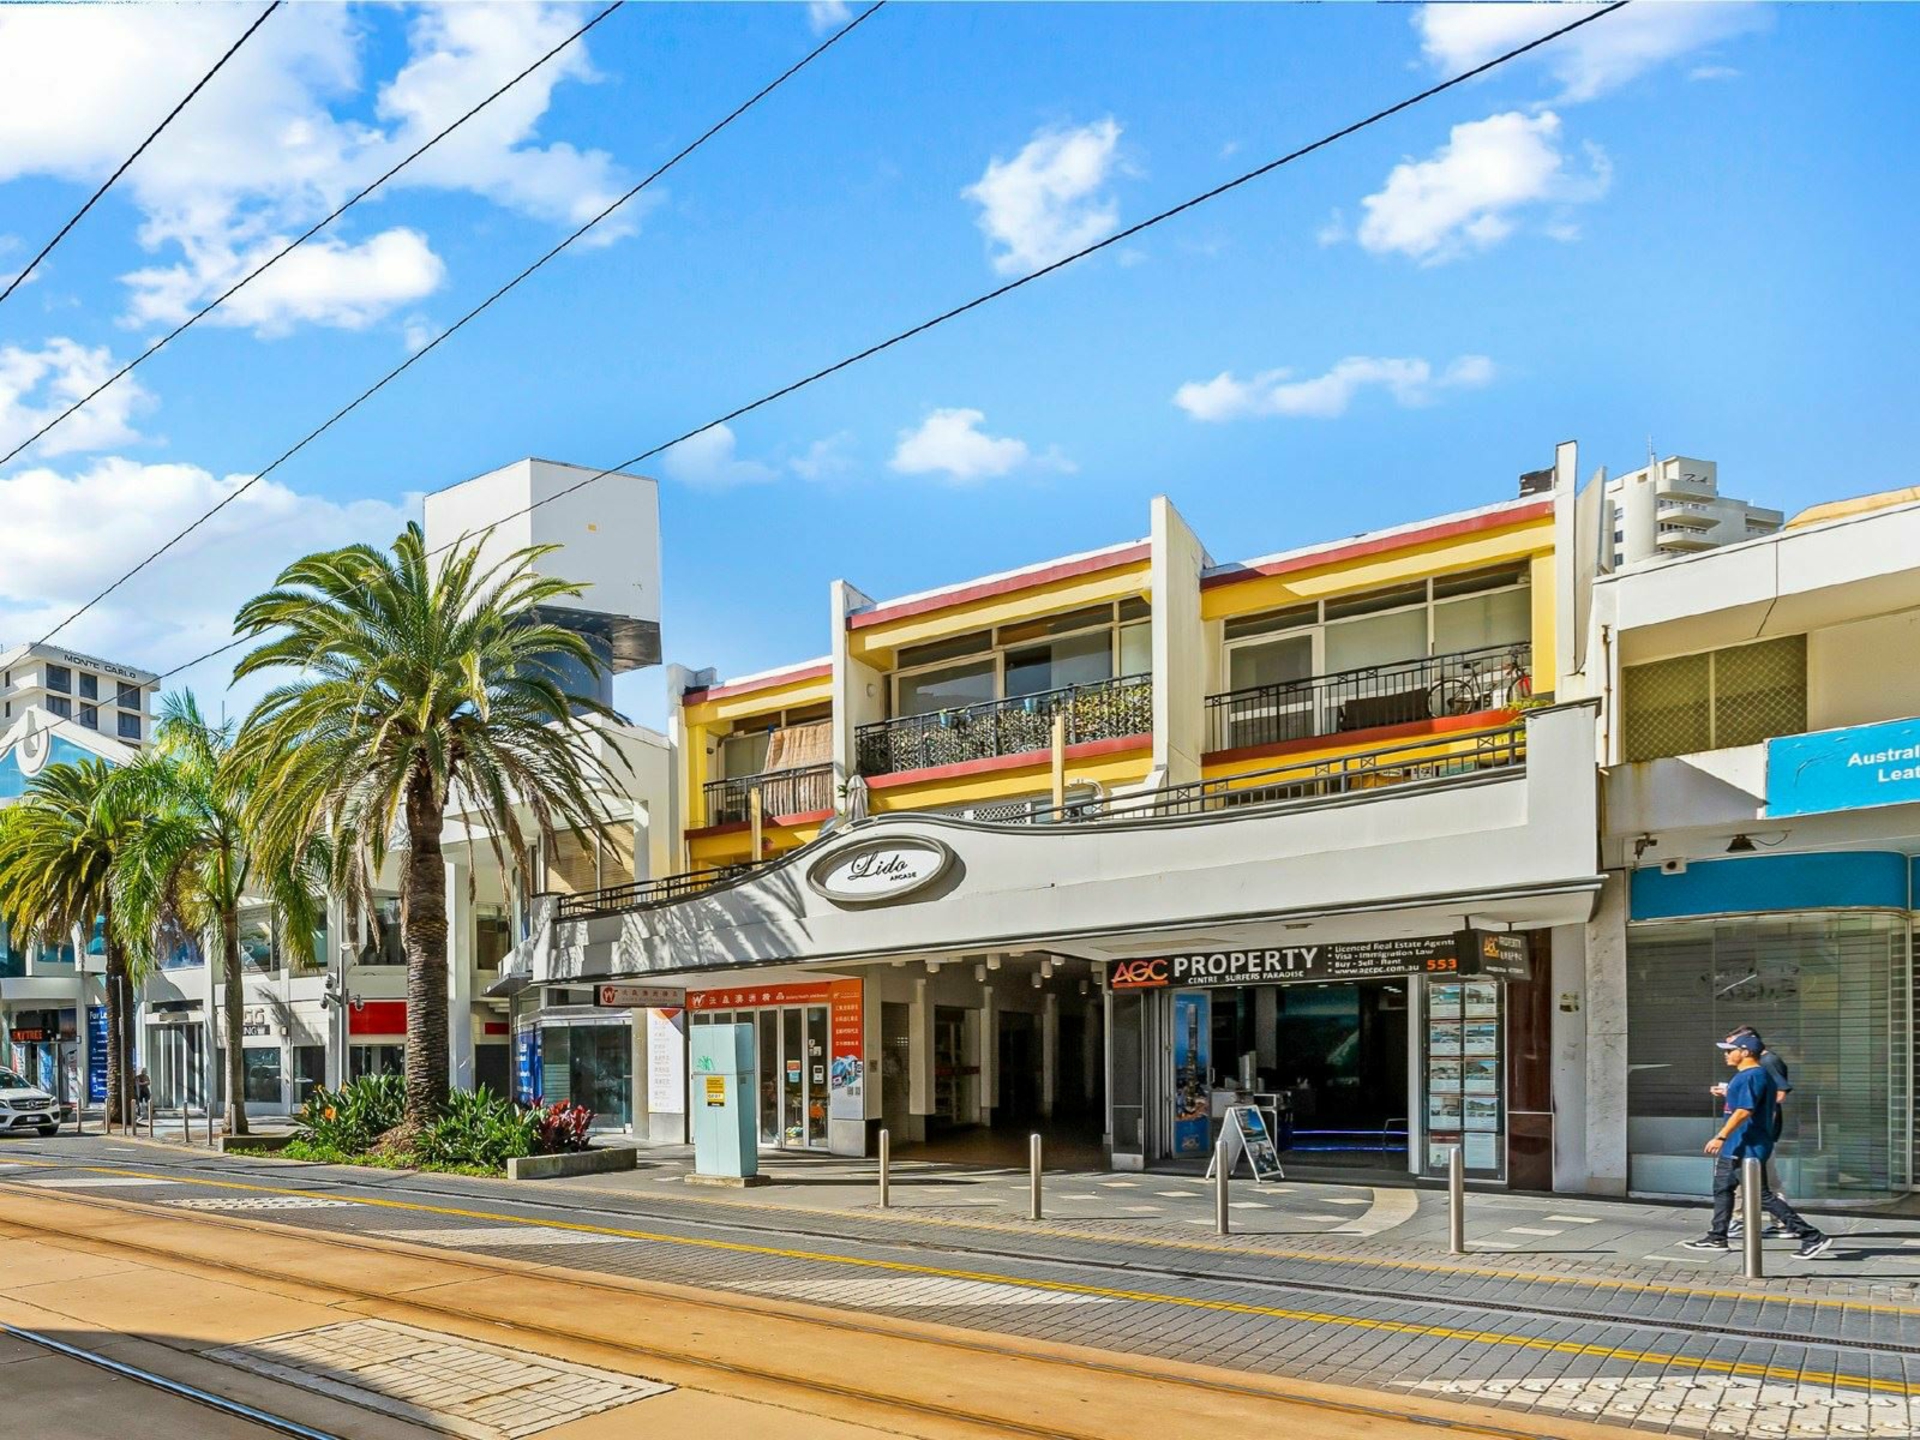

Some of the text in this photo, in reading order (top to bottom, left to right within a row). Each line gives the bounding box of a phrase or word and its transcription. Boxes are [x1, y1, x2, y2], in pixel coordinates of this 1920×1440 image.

[64, 654, 136, 678] MONTE CARLO
[1847, 744, 1920, 767] Austral
[847, 850, 908, 881] Lido
[889, 871, 917, 881] ARCADE
[1373, 941, 1392, 950] Real
[1394, 940, 1421, 949] Estate
[1424, 939, 1455, 948] Agents
[1335, 952, 1352, 960] Visa
[1359, 950, 1413, 959] Immigration
[1111, 947, 1318, 984] AGC PROPERTY
[1335, 961, 1350, 969] Buy
[1358, 959, 1373, 967] Sell
[1427, 958, 1457, 971] 553
[1188, 970, 1304, 984] CENTRE SURFERS PARADISE
